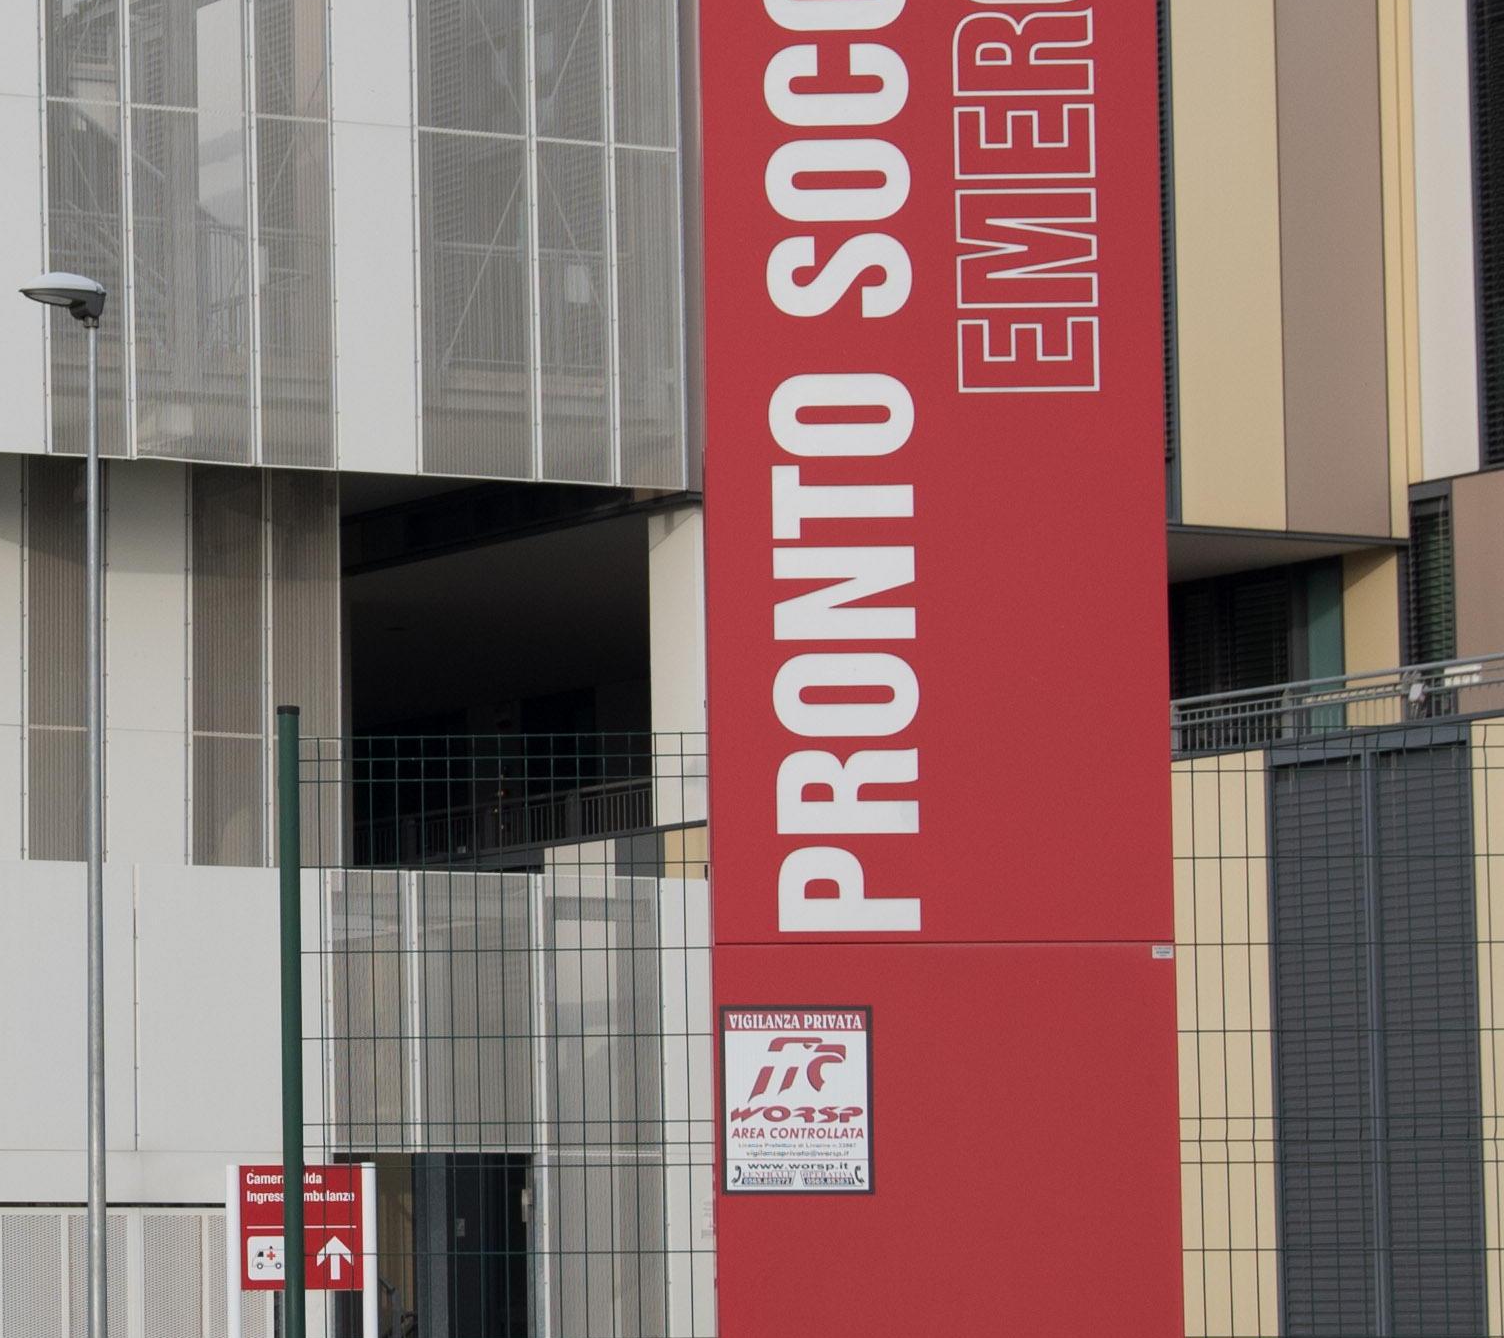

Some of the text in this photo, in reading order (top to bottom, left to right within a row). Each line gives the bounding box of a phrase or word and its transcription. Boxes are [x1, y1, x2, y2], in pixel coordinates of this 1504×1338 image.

[768, 372, 921, 933] PRONTO
[729, 1014, 863, 1029] VIGILANZA PRIVATA
[730, 1105, 864, 1124] WORSP
[731, 1127, 864, 1139] AREA CONTROLLATA
[747, 1162, 849, 1171] www.worsp.it
[246, 1172, 323, 1184] Camer lda
[246, 1190, 355, 1204] Ingress mbulanze
